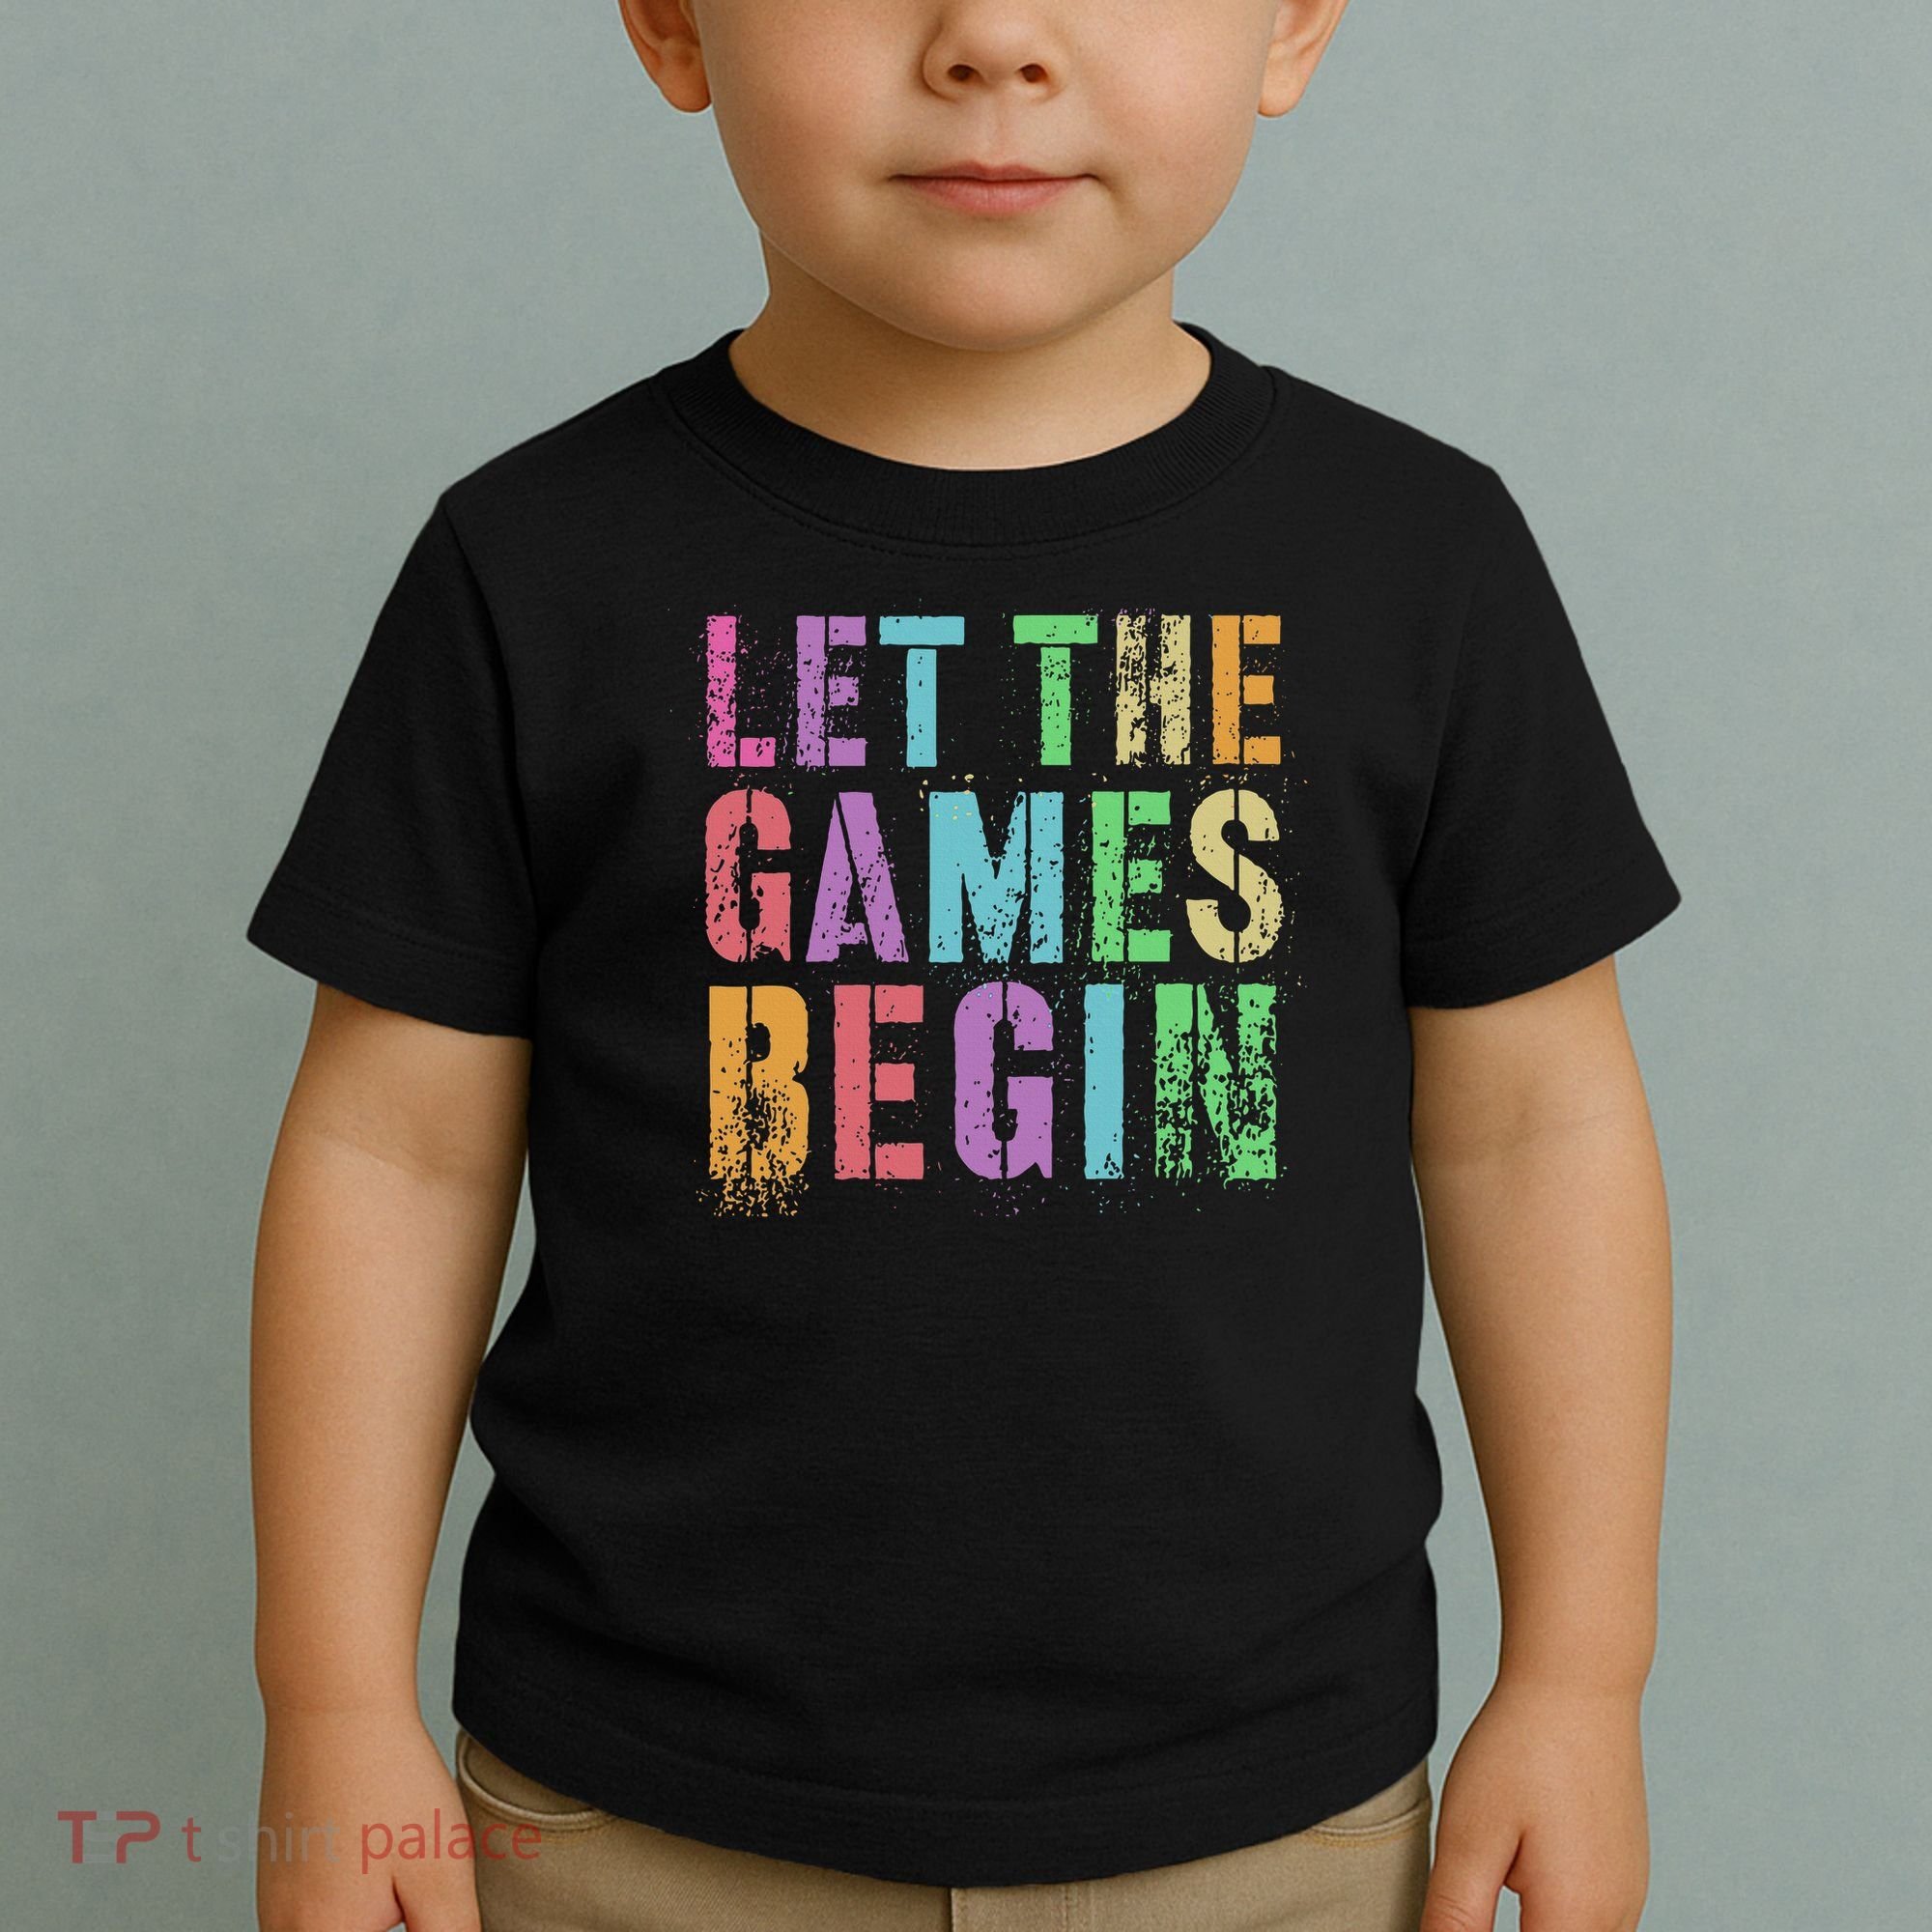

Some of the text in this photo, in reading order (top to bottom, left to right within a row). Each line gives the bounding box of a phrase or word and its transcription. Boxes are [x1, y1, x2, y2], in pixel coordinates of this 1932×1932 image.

[706, 614, 1281, 767] LET THE
[705, 788, 1283, 963] GAMES
[709, 981, 1276, 1180] BEGIN
